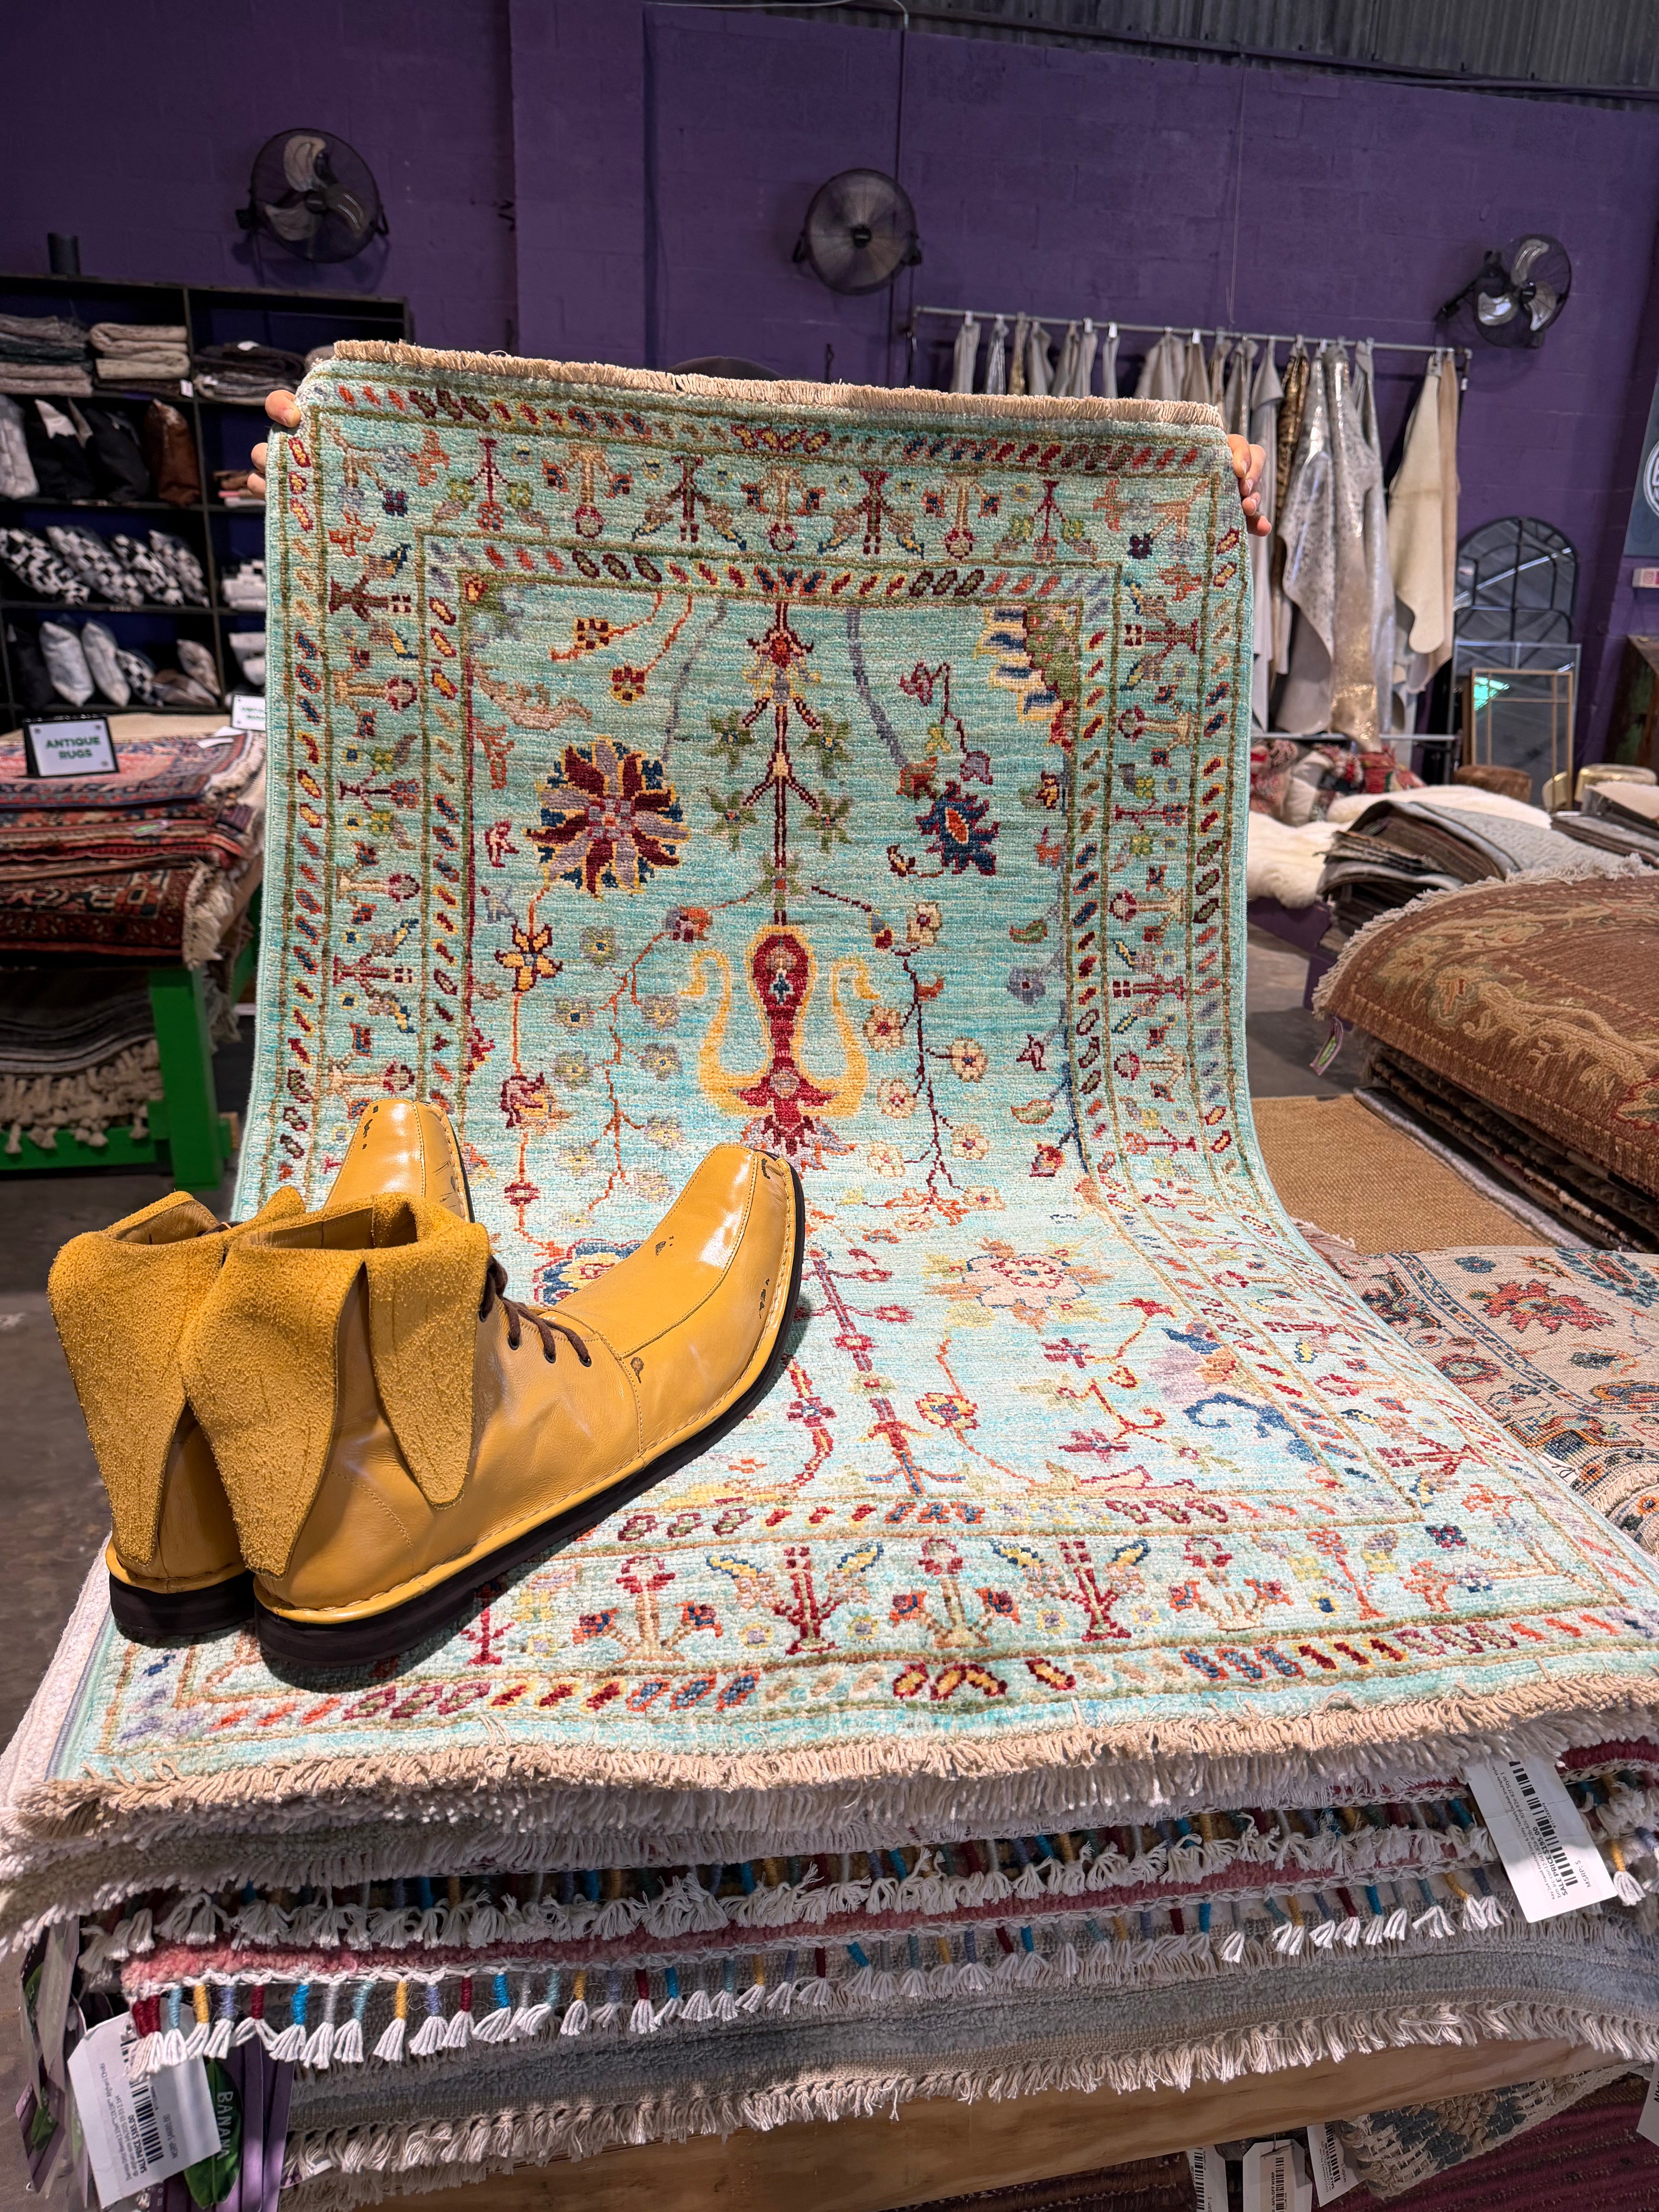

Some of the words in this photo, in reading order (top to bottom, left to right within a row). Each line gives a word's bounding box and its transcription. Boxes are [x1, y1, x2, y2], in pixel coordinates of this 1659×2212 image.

[46, 737, 101, 748] ANTIQUE
[59, 748, 93, 759] RUGS
[1532, 1826, 1549, 1854] $195.00
[1546, 1855, 1559, 1877] PRICE
[1578, 1865, 1591, 1887] MSRP:
[1555, 1877, 1568, 1896] SALE
[217, 2091, 234, 2160] BANANA
[132, 2138, 143, 2159] PRICE
[137, 2157, 147, 2174] SALE
